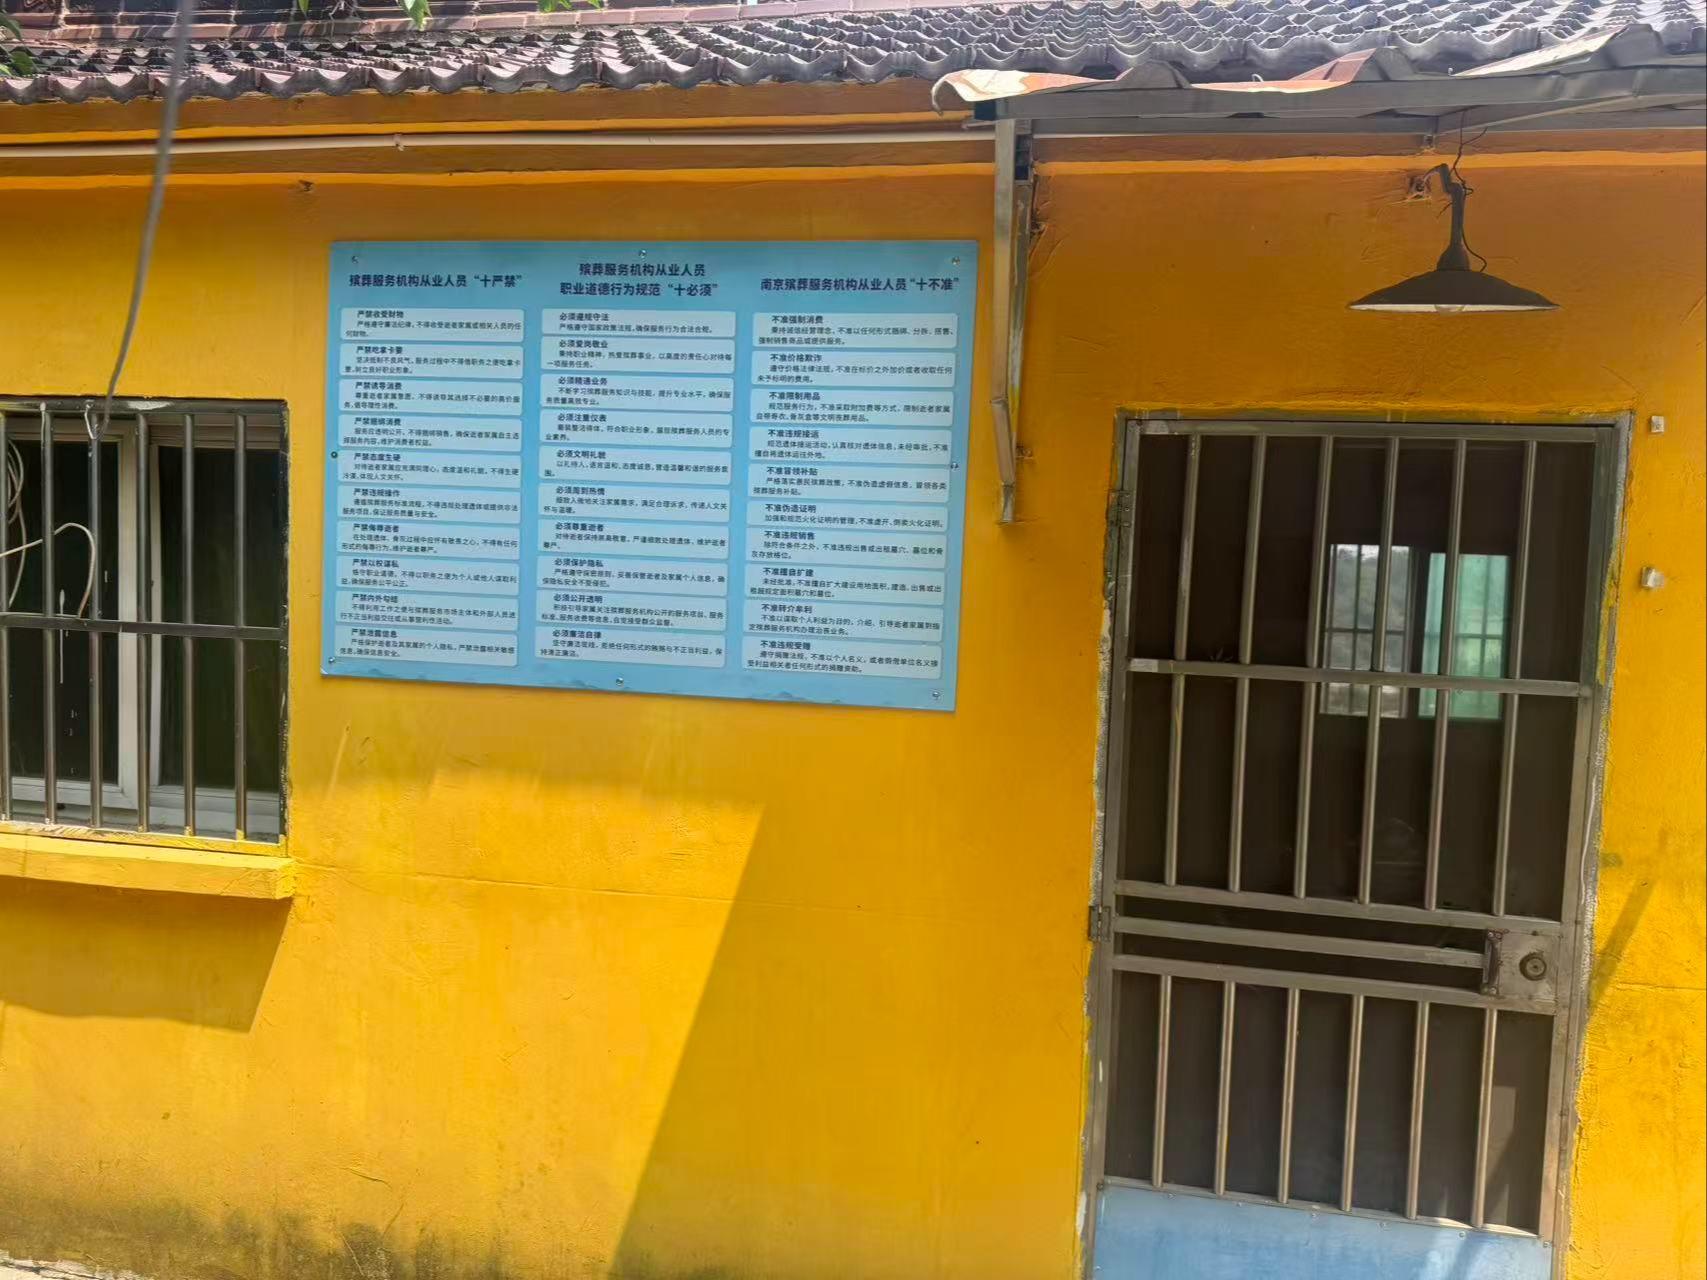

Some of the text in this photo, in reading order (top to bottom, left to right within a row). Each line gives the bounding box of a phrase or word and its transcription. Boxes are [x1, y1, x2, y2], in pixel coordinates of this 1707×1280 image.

[580, 264, 706, 276] 殡葬服务机构从业人员
[772, 315, 823, 324] 不准强制消费
[559, 340, 608, 348] 必须爱岗敬业
[356, 346, 403, 354] 严禁吃拿卡要
[770, 354, 822, 362] 不准价格欺诈
[558, 377, 607, 385] 必须精通业务
[355, 382, 402, 390] 严禁诱导消费
[769, 391, 820, 401] 不准限制用品
[558, 413, 606, 422] 必须注重仪表
[768, 430, 819, 439] 不准违规接运
[354, 453, 401, 461] 严禁态度生硬
[557, 450, 606, 459] 必须文明礼貌
[767, 466, 818, 476] 不准冒领补贴
[354, 488, 400, 497] 严禁违规操作
[556, 486, 605, 495] 必须周到热情
[765, 504, 816, 513] 不准伪造证明
[555, 522, 604, 532] 必须尊重逝者
[764, 531, 815, 540] 不准违规销售
[353, 559, 399, 568] 严禁以权谋私
[555, 558, 603, 567] 必须保护隐私
[763, 568, 814, 577] 不准擅自扩建
[352, 594, 398, 603] 严禁内外勾结
[554, 593, 603, 603] 必须公开透明
[761, 604, 812, 614] 不准转介牟利
[351, 628, 397, 638] 严禁泄露信息
[552, 630, 602, 639] 必须廉洁自律
[760, 640, 811, 650] 不准违规受赠
